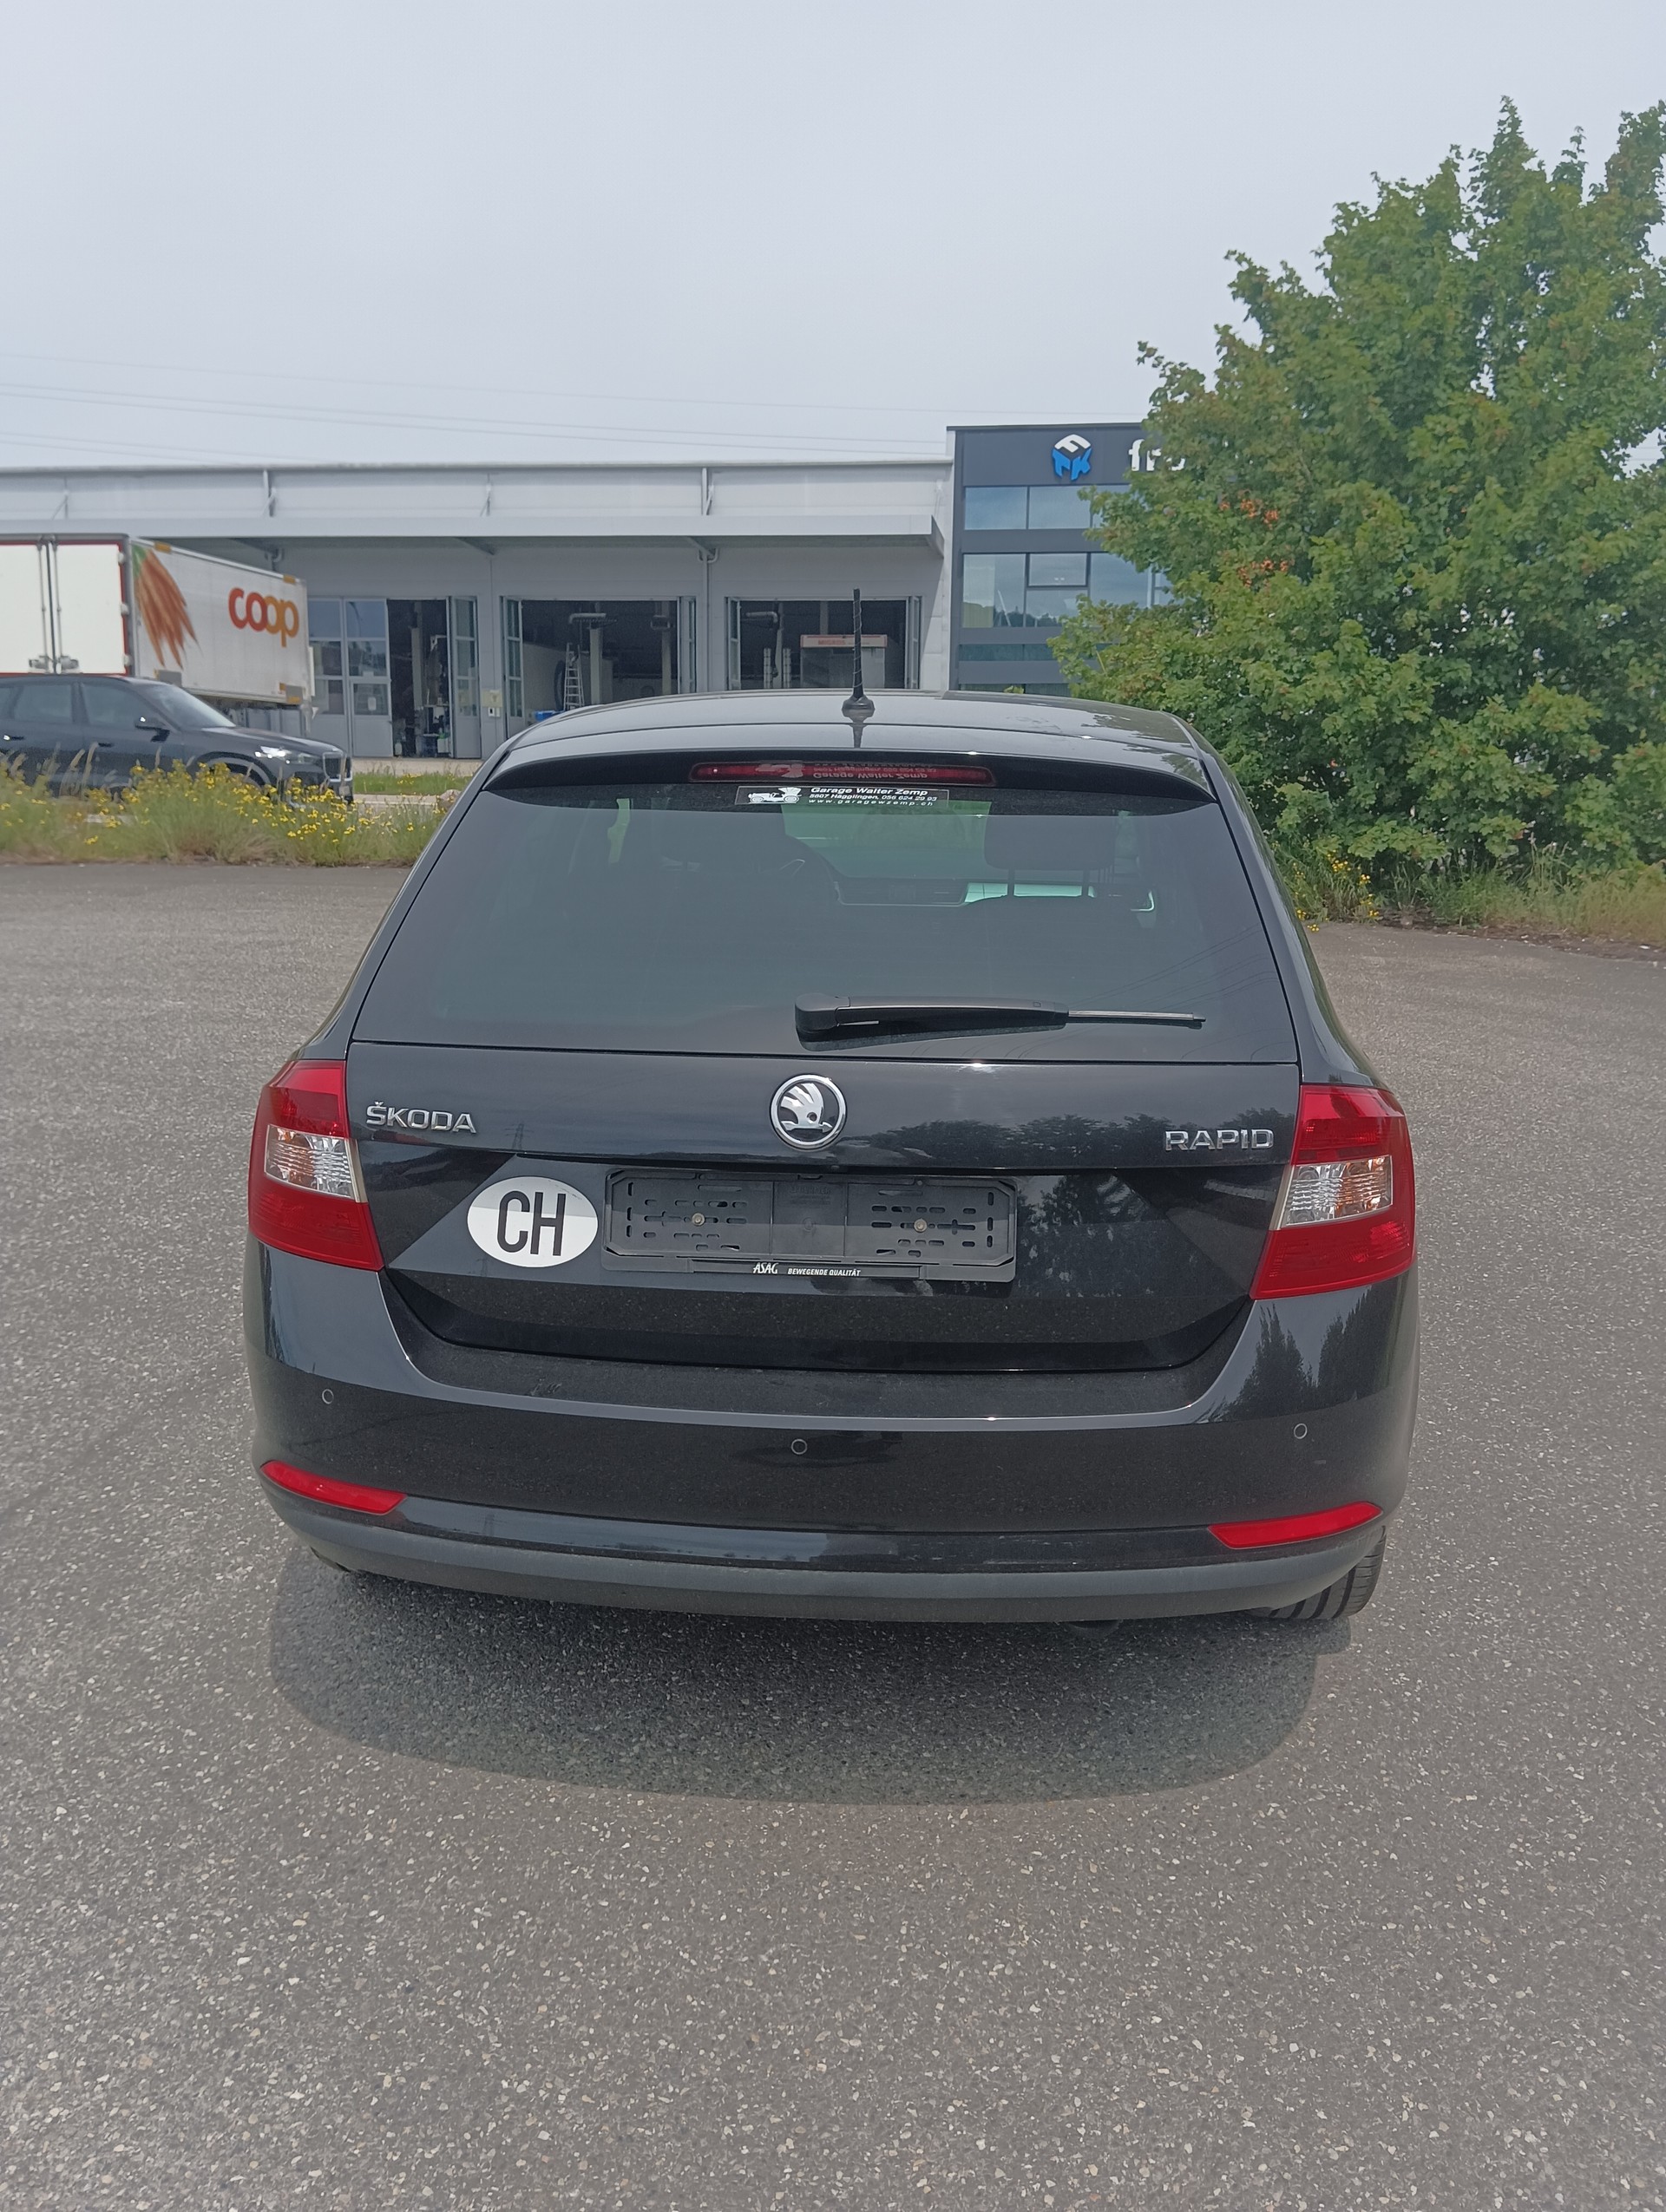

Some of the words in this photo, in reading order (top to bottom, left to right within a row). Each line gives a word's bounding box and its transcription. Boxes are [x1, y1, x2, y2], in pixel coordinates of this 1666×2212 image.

[228, 587, 300, 648] coop
[366, 1101, 477, 1134] ŠKODA
[1165, 1129, 1274, 1151] RAPID
[497, 1190, 567, 1257] CH
[787, 1267, 828, 1276] BEWEGENDE
[829, 1268, 861, 1277] QUALITÄT
